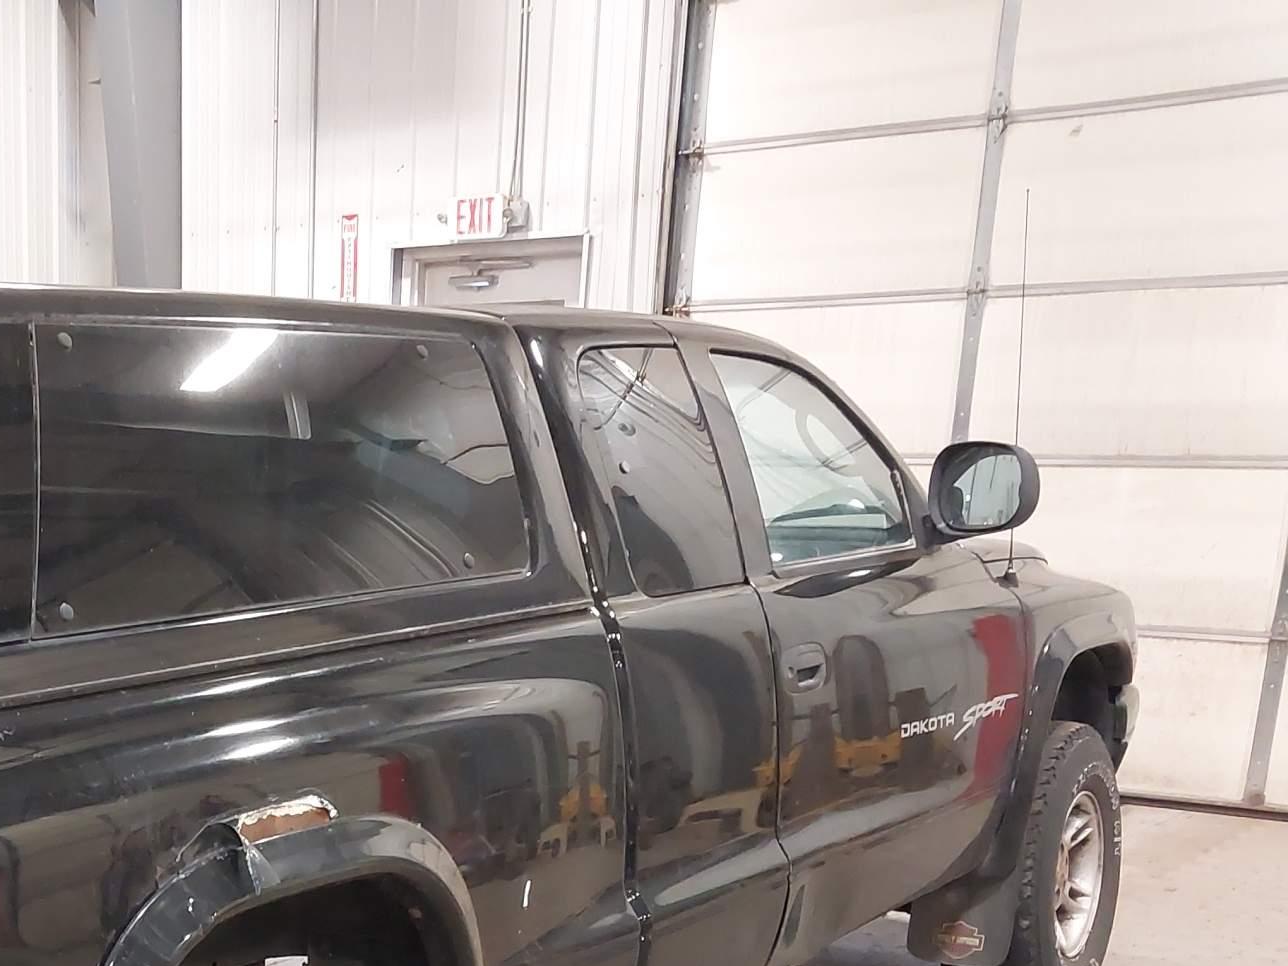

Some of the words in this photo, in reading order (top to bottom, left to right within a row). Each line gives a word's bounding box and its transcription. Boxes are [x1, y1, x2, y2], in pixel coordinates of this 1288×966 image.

[457, 197, 495, 234] EXIT
[900, 712, 955, 738] DAKOTA
[953, 693, 1019, 741] SPORT
